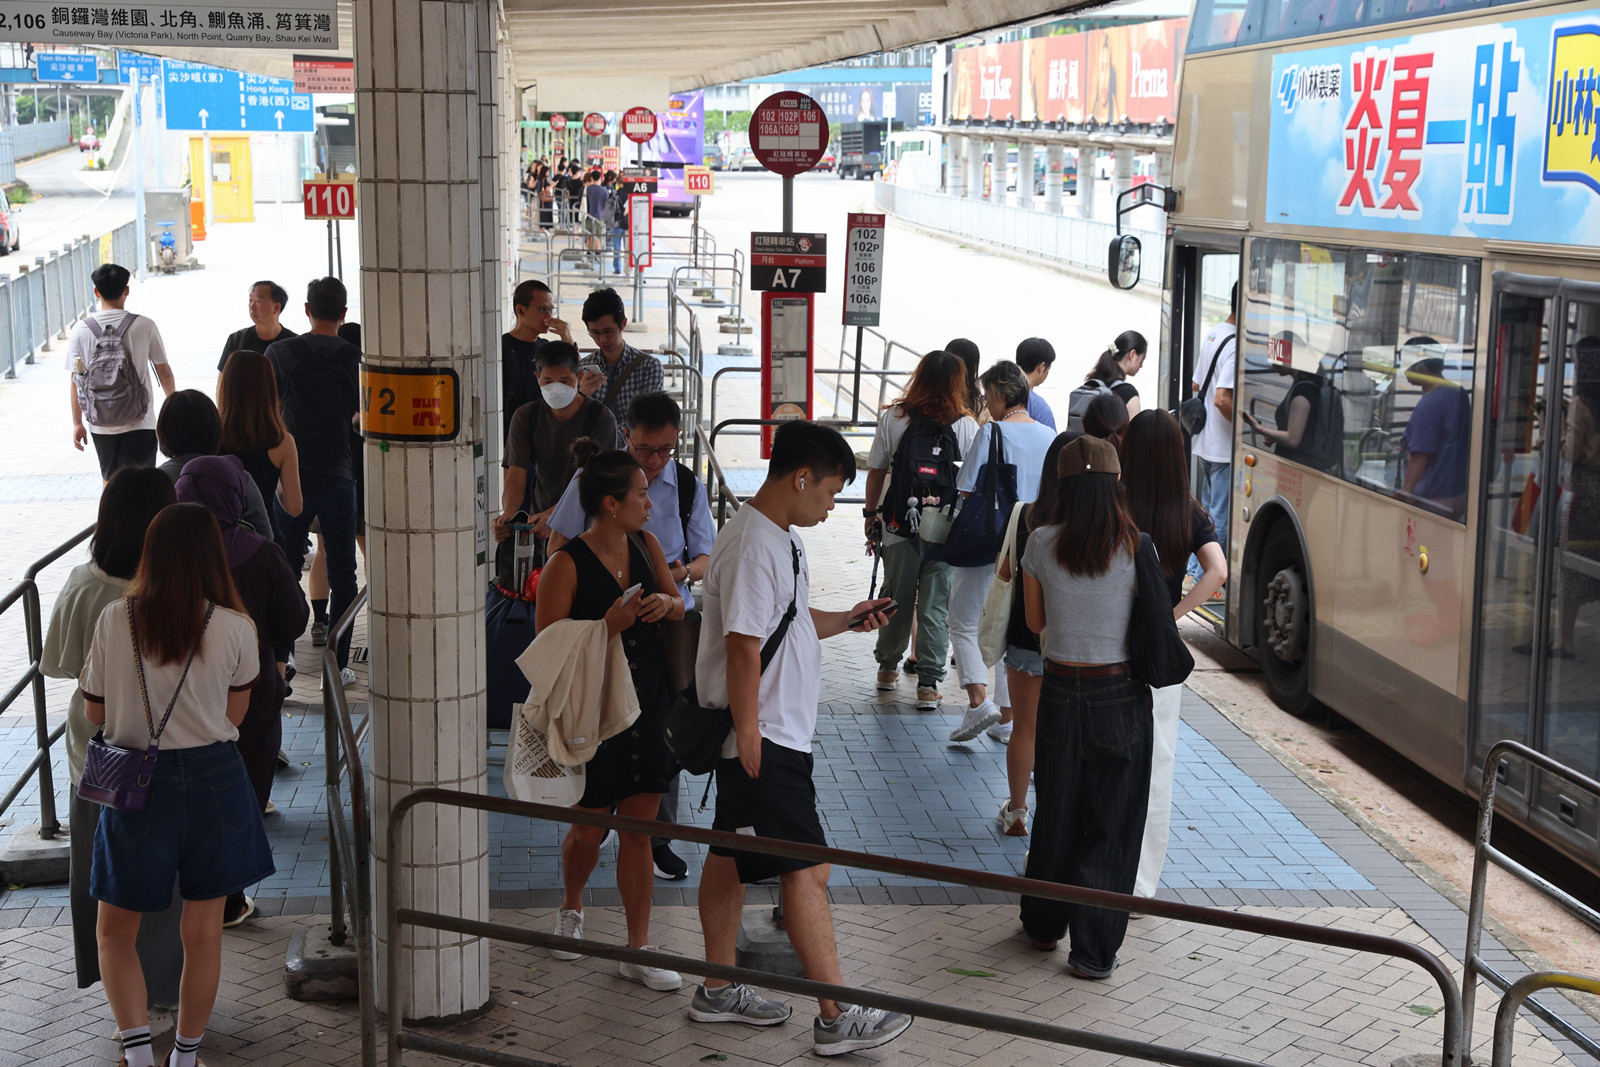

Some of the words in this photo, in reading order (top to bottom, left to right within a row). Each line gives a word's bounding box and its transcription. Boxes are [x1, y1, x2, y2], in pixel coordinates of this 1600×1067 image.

[52, 28, 95, 39] Causeway
[97, 30, 113, 40] Bay
[116, 30, 148, 40] (Victoria
[151, 31, 175, 41] Park),
[202, 33, 224, 42] Point,
[226, 34, 253, 43] Quarry
[256, 34, 273, 43] Bay,
[168, 72, 223, 83] 尖沙咀(東)
[1130, 51, 1168, 98] Prema
[246, 85, 267, 94] Hong
[269, 86, 289, 94] Kong
[248, 95, 290, 106] 香港(西)
[762, 111, 775, 121] 102
[780, 111, 798, 122] 102P
[803, 111, 816, 121] 106
[760, 124, 778, 134] 106A
[780, 124, 798, 134] 106P
[633, 183, 647, 192] A6
[690, 176, 708, 188] 110
[307, 186, 350, 215] 110
[857, 229, 877, 240] 102
[853, 242, 880, 252] 102P
[855, 262, 875, 273] 106
[772, 268, 802, 288] A7
[851, 275, 878, 285] 106P
[850, 294, 877, 304] 106A
[379, 388, 395, 415] 2
